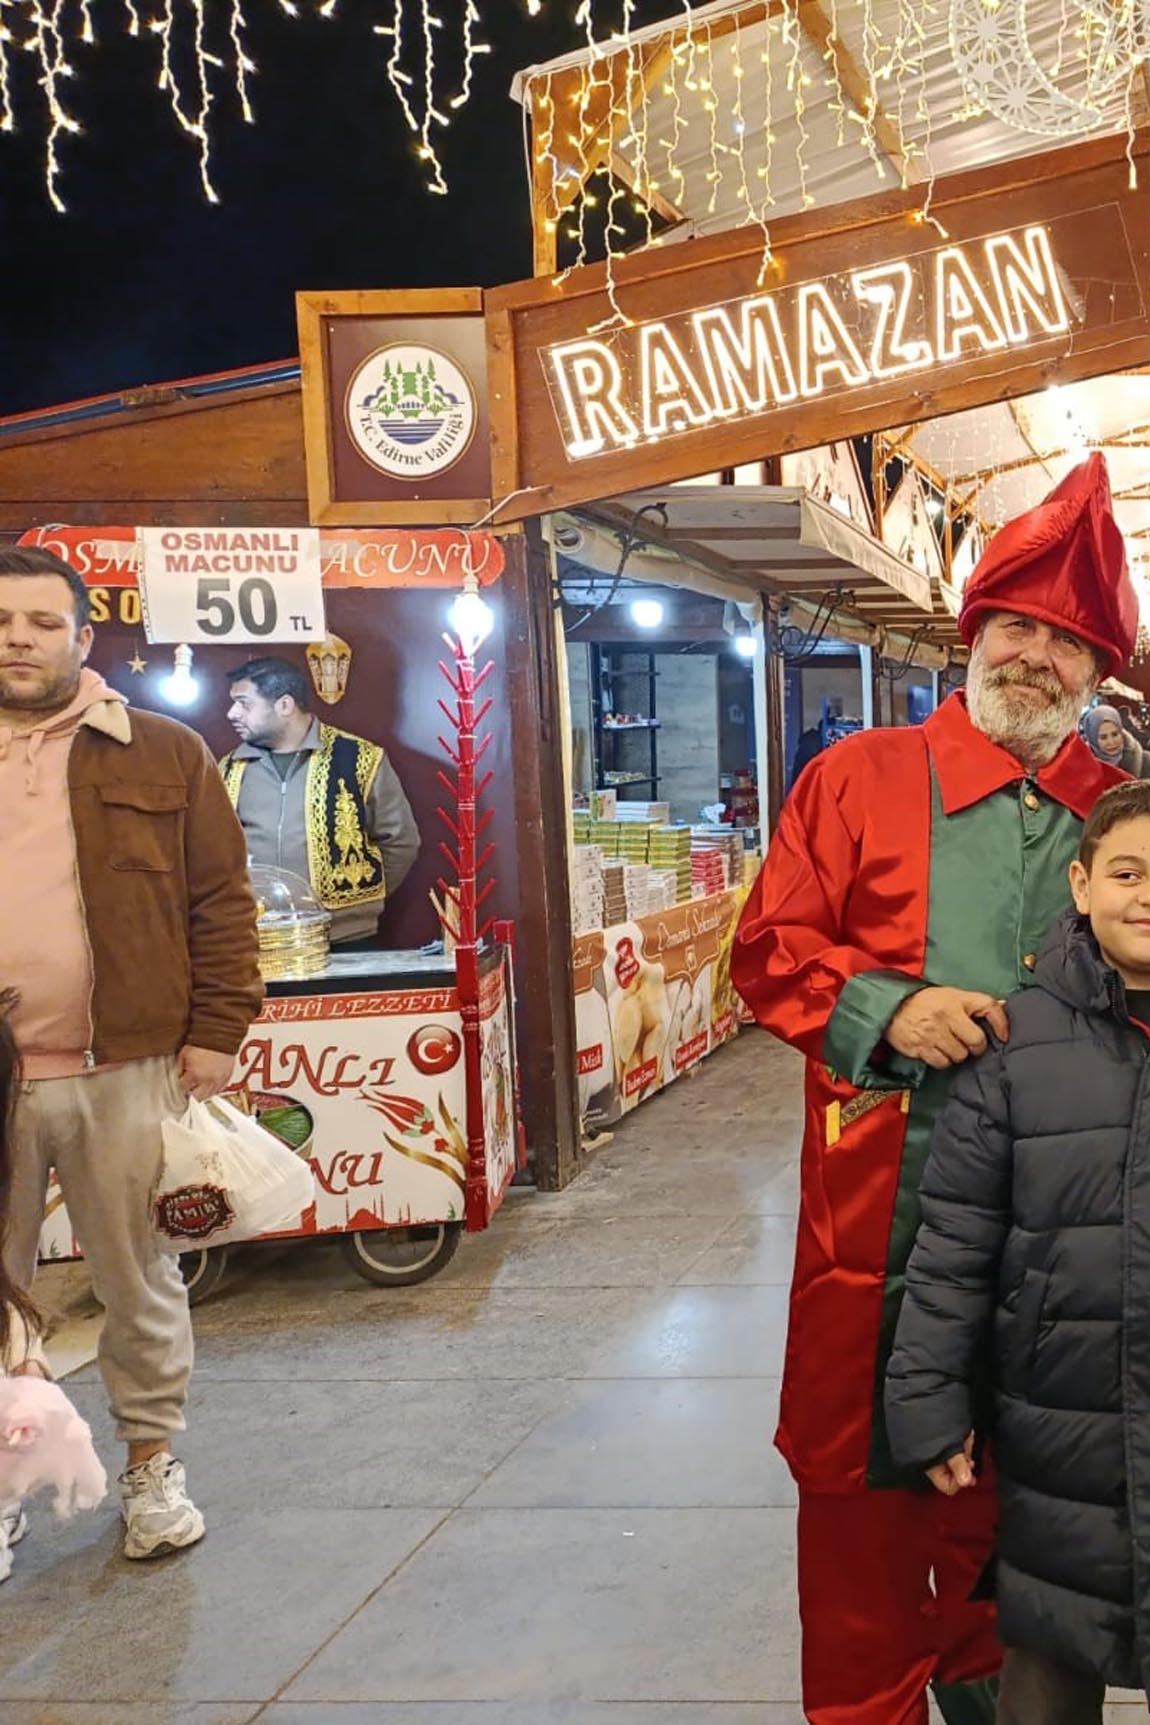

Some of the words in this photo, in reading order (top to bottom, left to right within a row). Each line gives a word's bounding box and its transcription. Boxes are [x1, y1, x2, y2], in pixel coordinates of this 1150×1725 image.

[550, 226, 1069, 458] RAMAZAN
[375, 439, 423, 466] Edirne
[161, 532, 299, 552] OSMANLI
[321, 538, 490, 578] ACUNU
[165, 554, 298, 573] MACUNU
[195, 576, 277, 636] 50
[289, 615, 313, 631] TL
[256, 998, 323, 1022] RİHİ
[329, 989, 452, 1017] LEZZETİ
[218, 1037, 397, 1096] ANLI
[307, 1150, 384, 1195] NU
